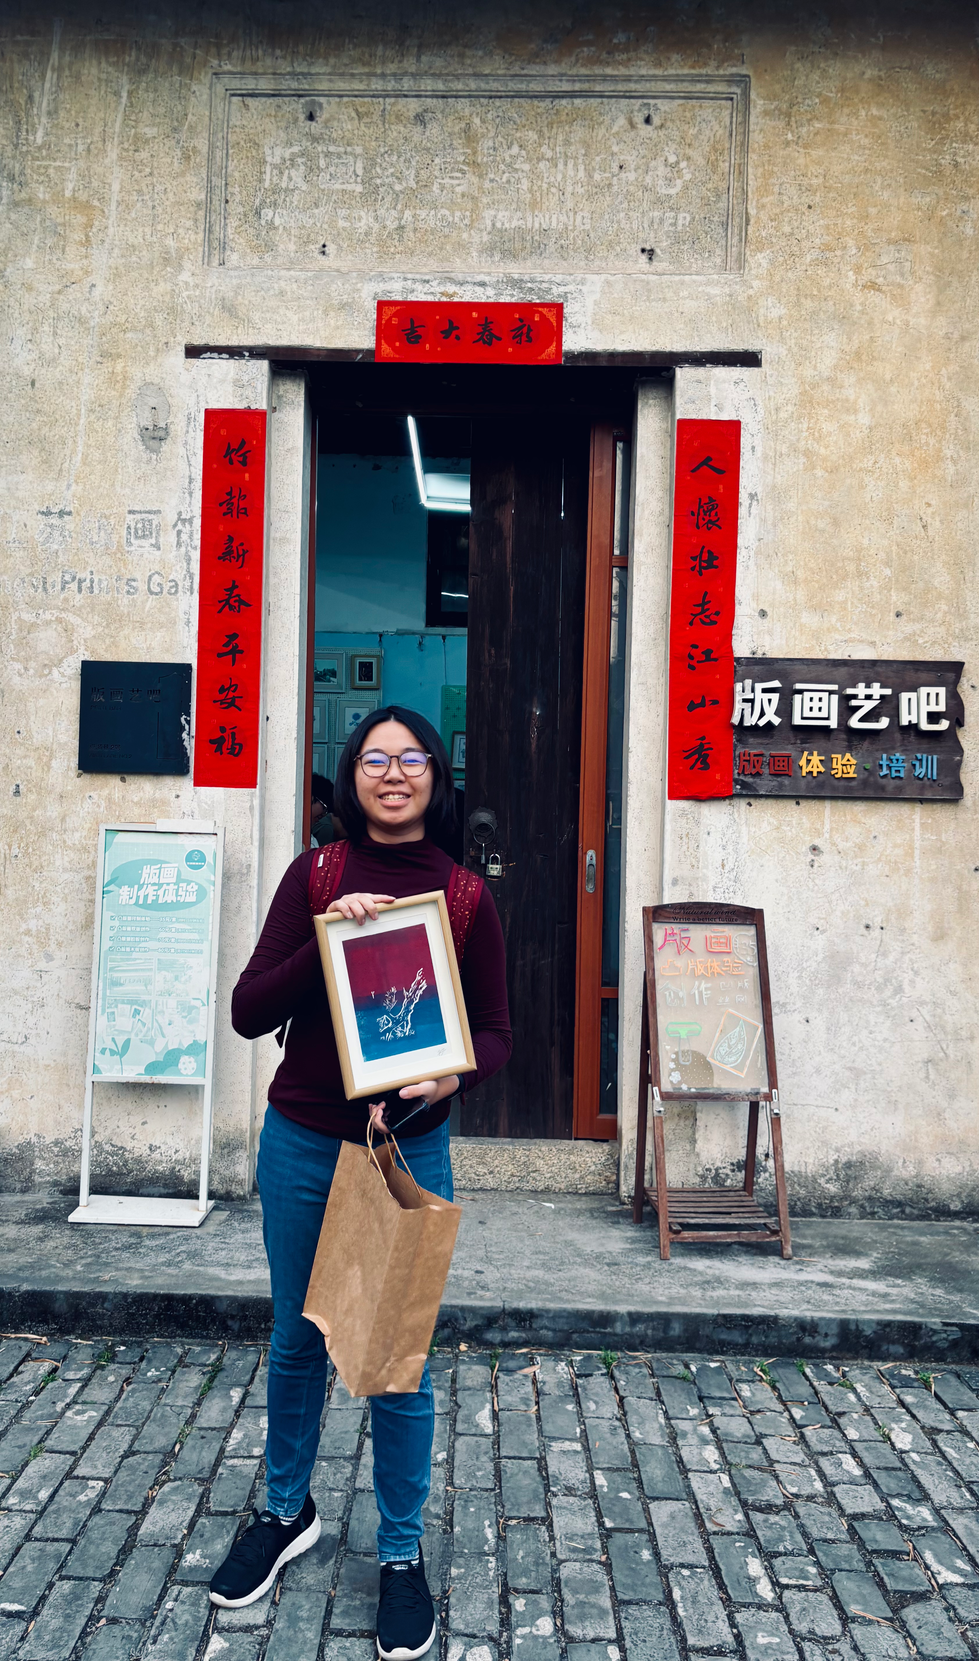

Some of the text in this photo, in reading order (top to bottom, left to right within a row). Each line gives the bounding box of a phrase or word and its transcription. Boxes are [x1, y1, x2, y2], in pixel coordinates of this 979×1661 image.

[484, 210, 592, 230] TRAINING
[89, 686, 162, 703] 版画艺吧
[730, 679, 950, 731] 版画艺吧
[140, 863, 178, 884] 版画
[118, 882, 199, 905] 制作体验
[657, 926, 733, 955] 版画
[660, 958, 745, 977] 凸版体验
